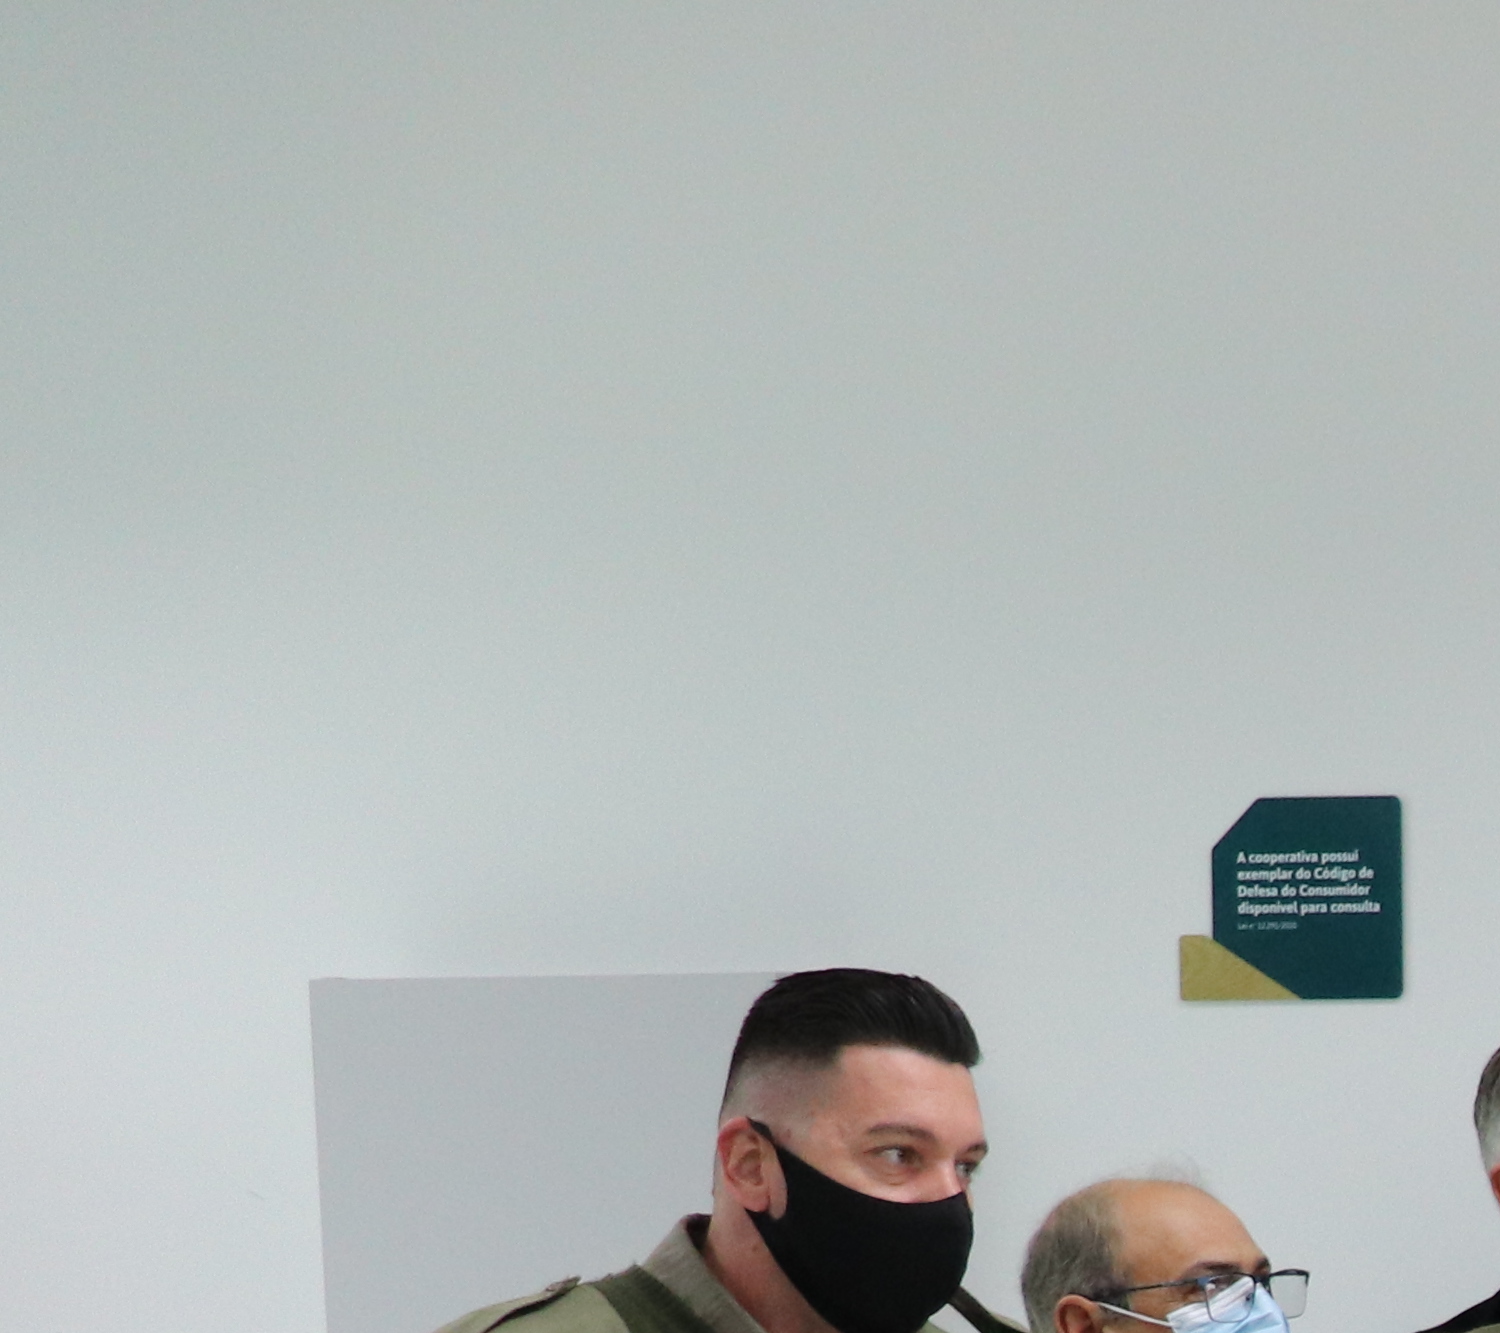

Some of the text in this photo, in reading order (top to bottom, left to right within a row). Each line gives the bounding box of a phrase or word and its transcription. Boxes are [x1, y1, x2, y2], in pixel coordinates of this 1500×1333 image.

[1237, 849, 1359, 866] A cooperativa possui
[1237, 866, 1374, 882] exemplar do Código de
[1237, 883, 1371, 898] Defesa do Consumidor
[1300, 903, 1328, 916] para
[1330, 900, 1381, 913] consulta
